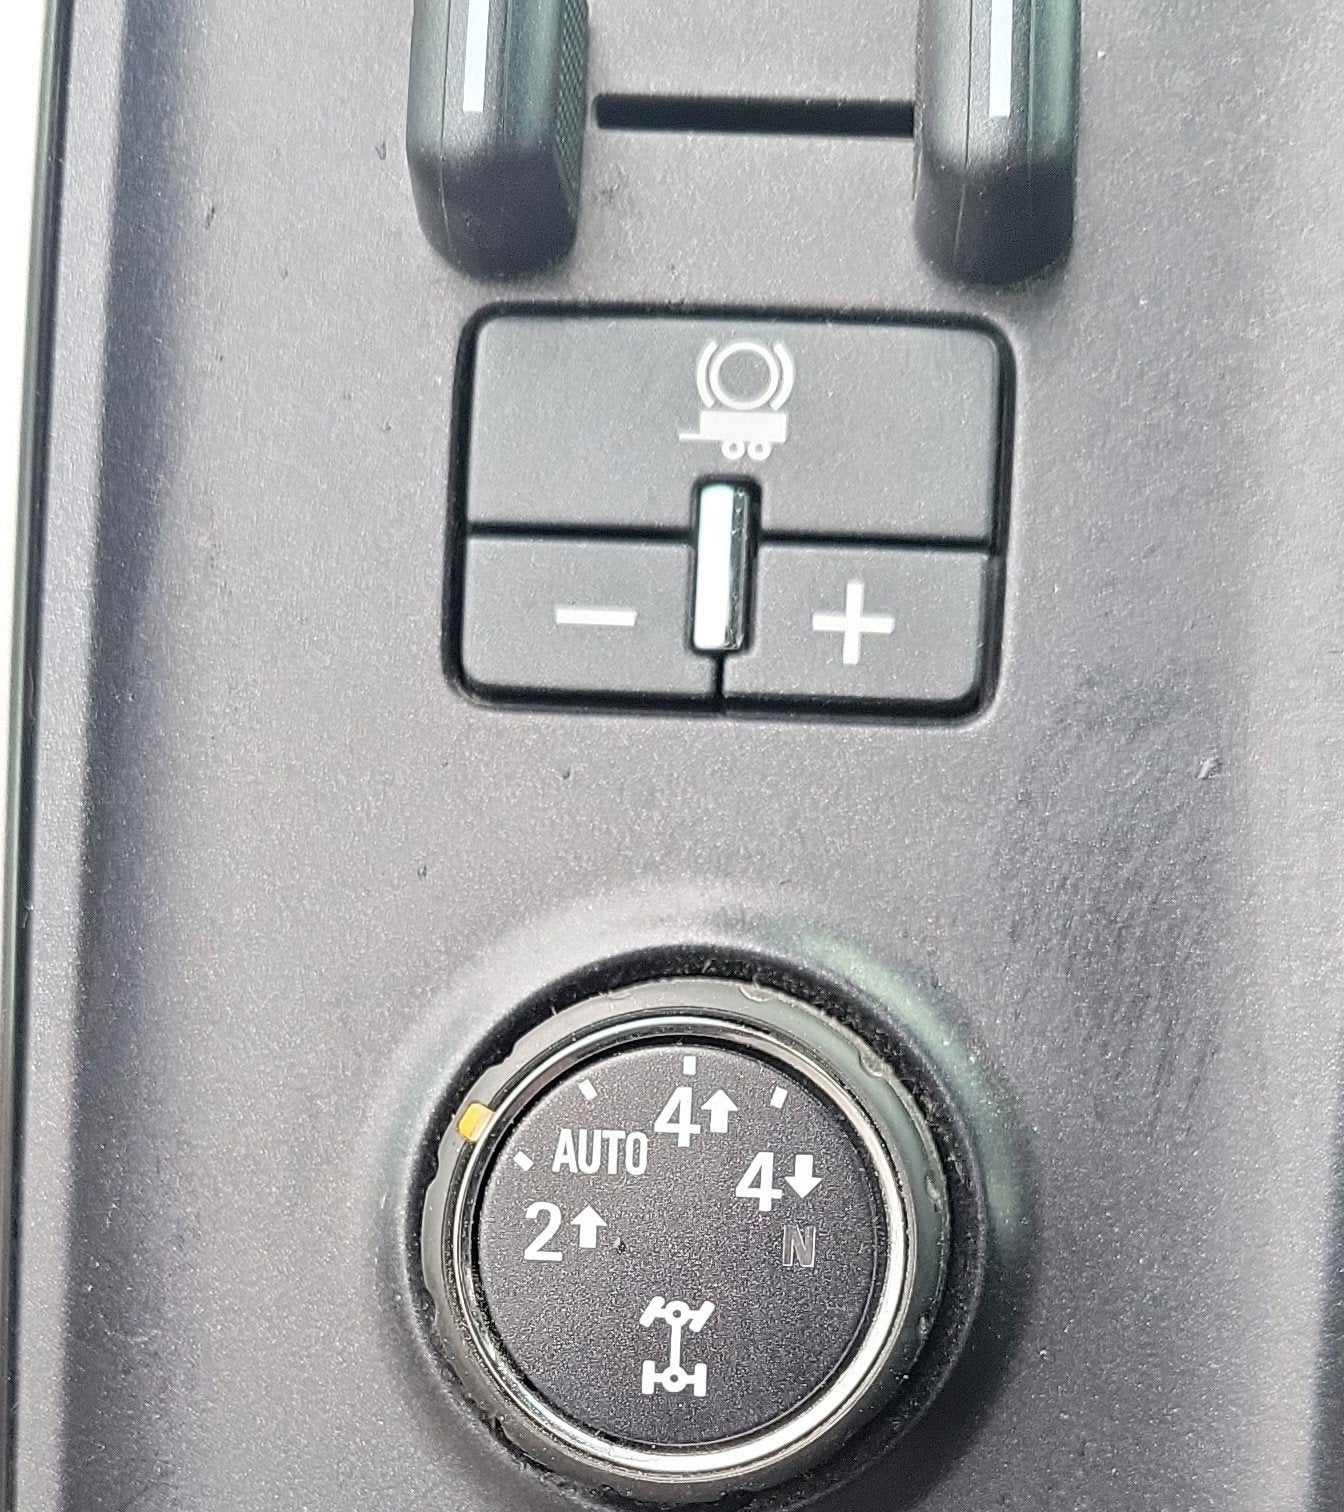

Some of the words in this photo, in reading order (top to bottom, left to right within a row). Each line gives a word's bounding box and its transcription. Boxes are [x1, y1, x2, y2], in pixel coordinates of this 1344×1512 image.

[654, 1086, 700, 1147] 4
[552, 1129, 649, 1175] AUTO
[735, 1152, 782, 1212] 4
[524, 1202, 563, 1261] 2
[782, 1225, 816, 1267] N
